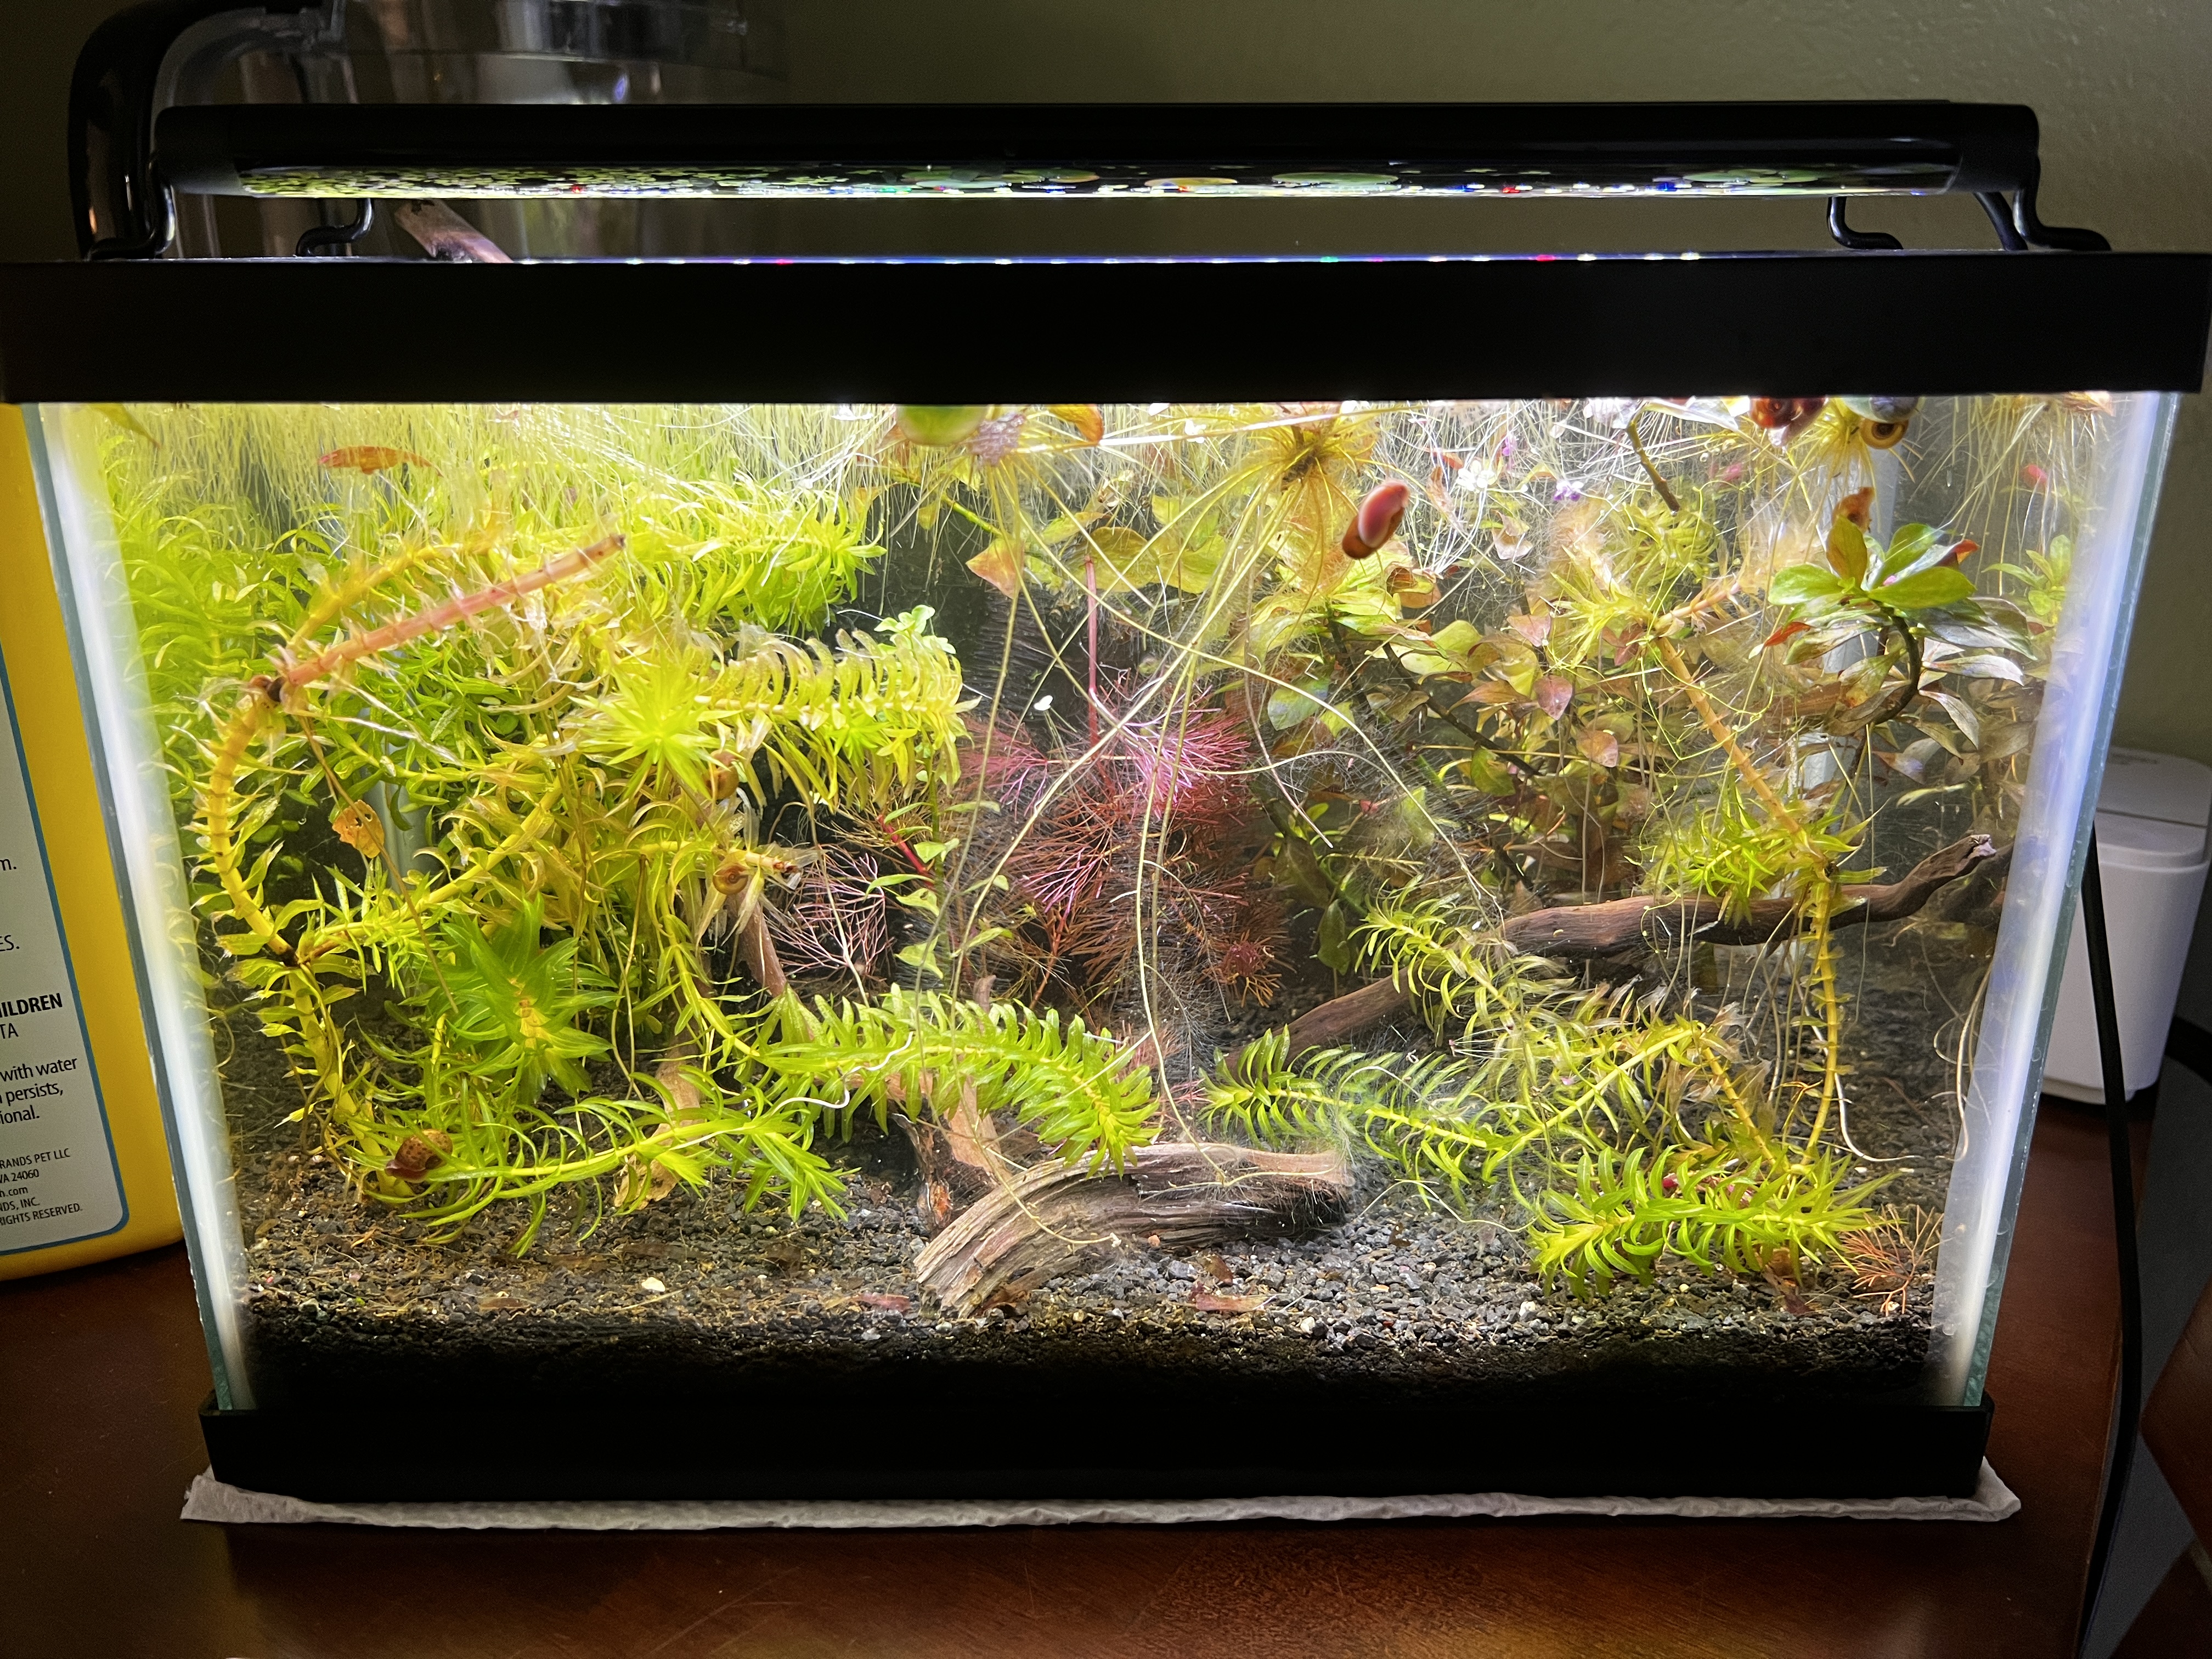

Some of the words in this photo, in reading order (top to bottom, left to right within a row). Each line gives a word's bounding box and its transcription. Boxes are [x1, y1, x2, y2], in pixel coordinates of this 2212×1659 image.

[0, 1063, 33, 1082] with
[35, 1058, 77, 1076] water
[5, 1082, 63, 1107] persists,
[33, 1151, 51, 1164] PET
[53, 1148, 70, 1160] LLC
[10, 1169, 40, 1182] 24060
